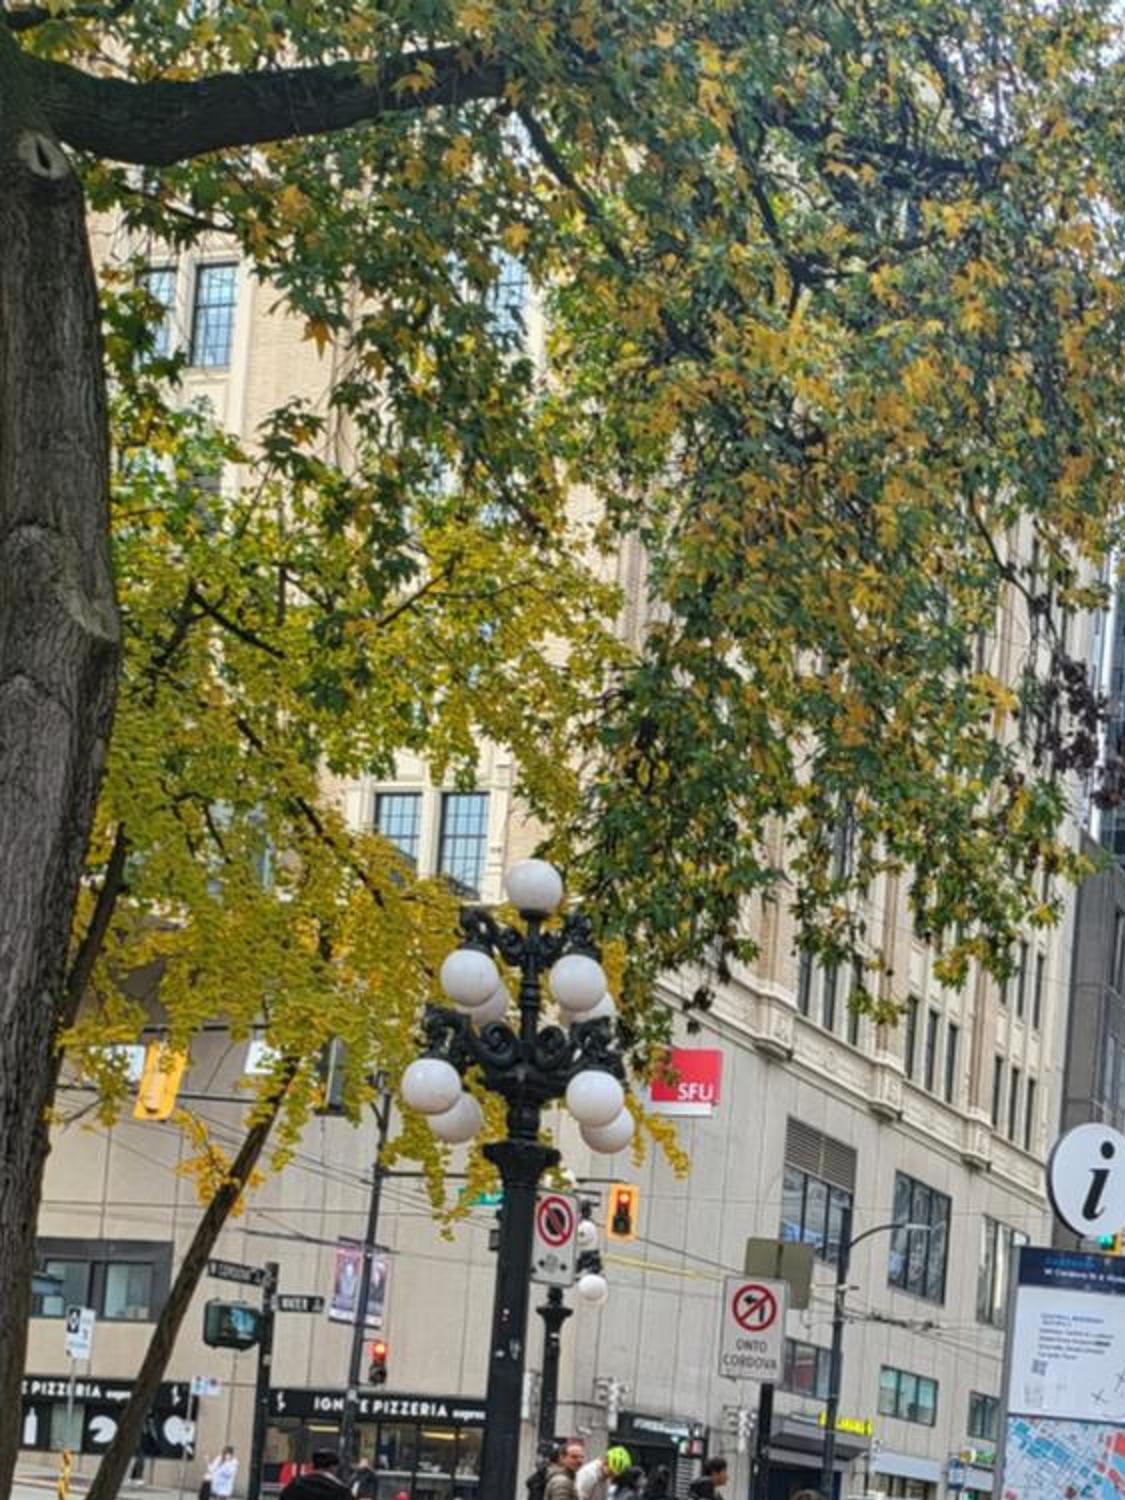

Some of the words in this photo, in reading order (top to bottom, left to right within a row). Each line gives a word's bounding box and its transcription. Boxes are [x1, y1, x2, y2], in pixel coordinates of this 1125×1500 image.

[678, 1082, 714, 1101] SFU
[736, 1339, 767, 1353] ONTO
[313, 1396, 369, 1413] IGNE
[372, 1399, 448, 1418] PIZZERIA
